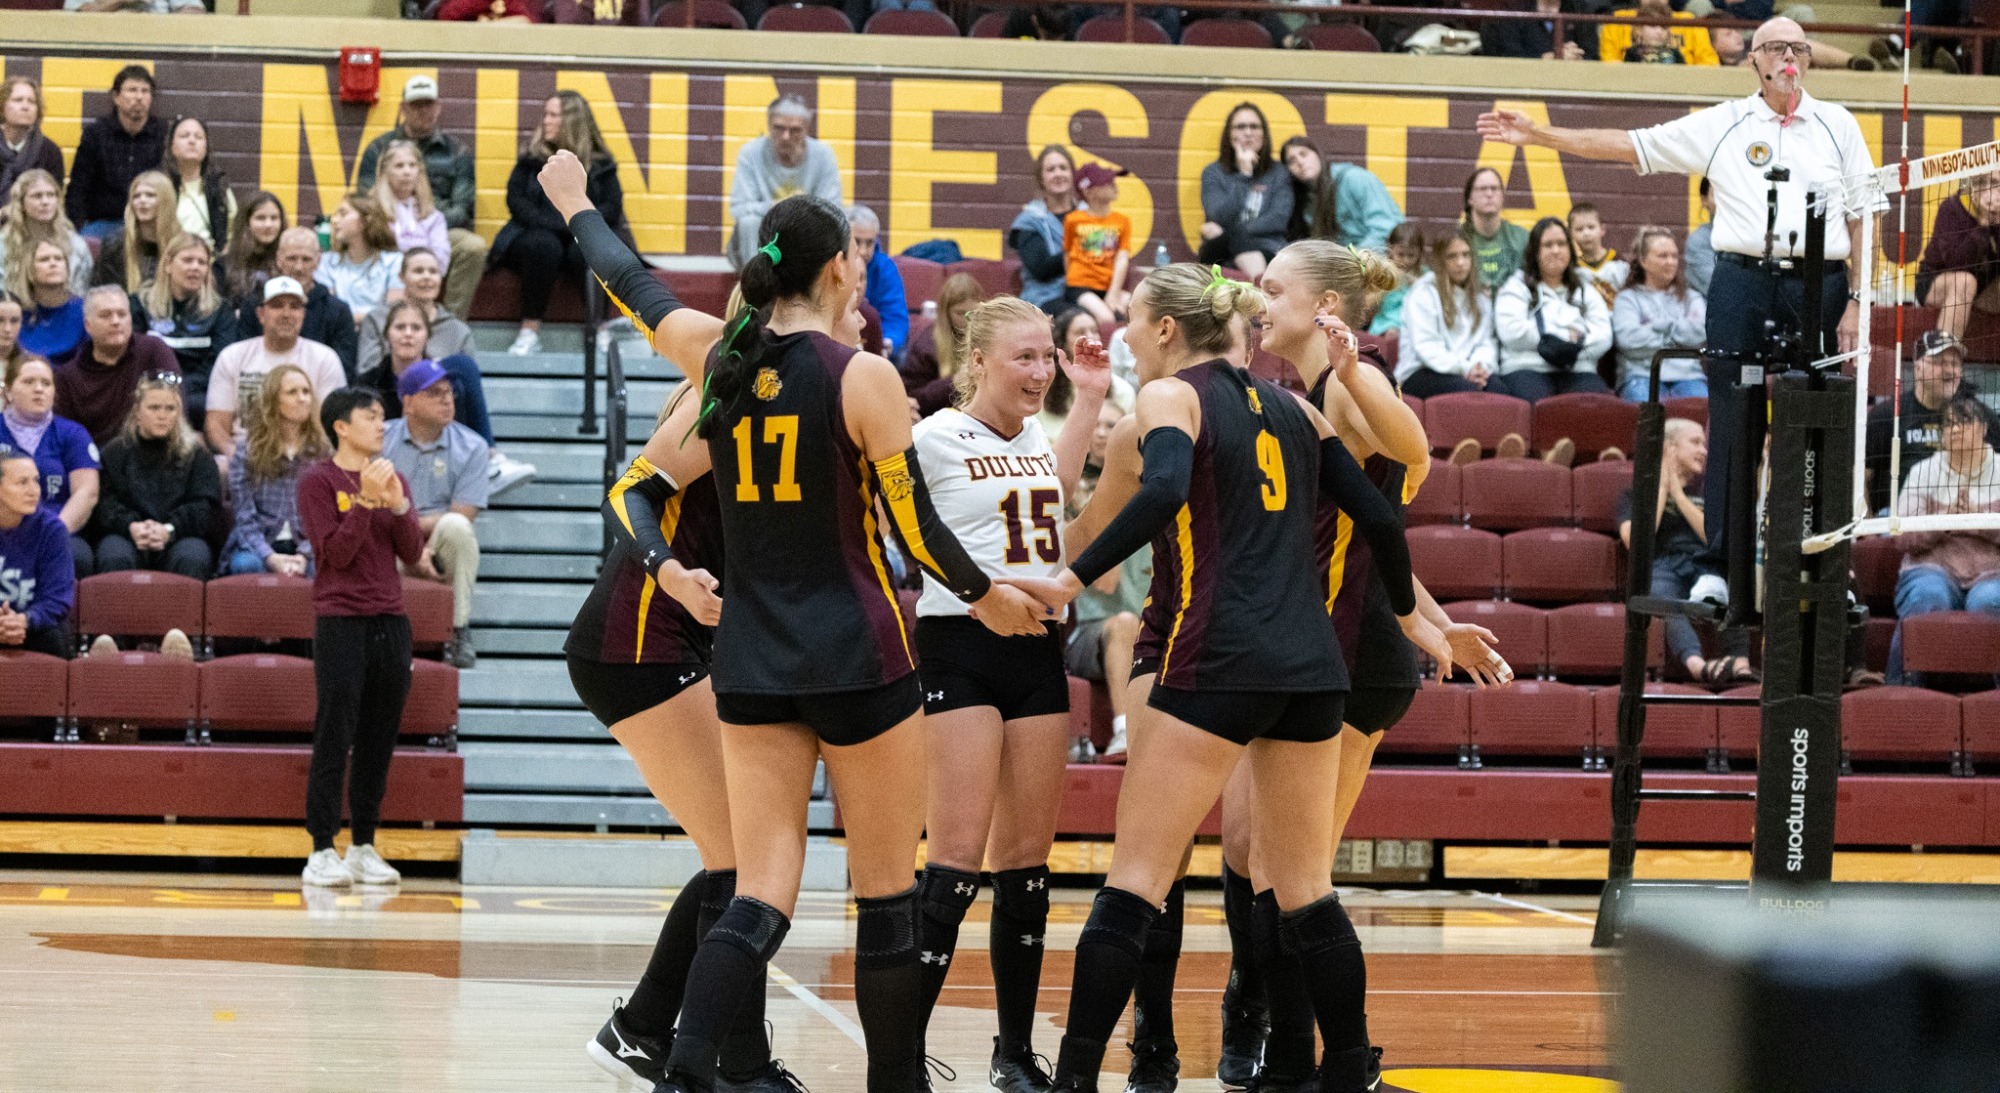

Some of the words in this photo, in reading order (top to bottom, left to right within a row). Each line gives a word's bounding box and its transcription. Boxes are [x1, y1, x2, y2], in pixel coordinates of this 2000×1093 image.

[258, 63, 1572, 261] MINNESOTA
[733, 415, 802, 502] 17
[1256, 429, 1287, 511] 9
[998, 487, 1061, 566] 15
[1790, 728, 1809, 791] sports
[1786, 794, 1805, 872] imports
[1760, 897, 1825, 911] BULLDOG
